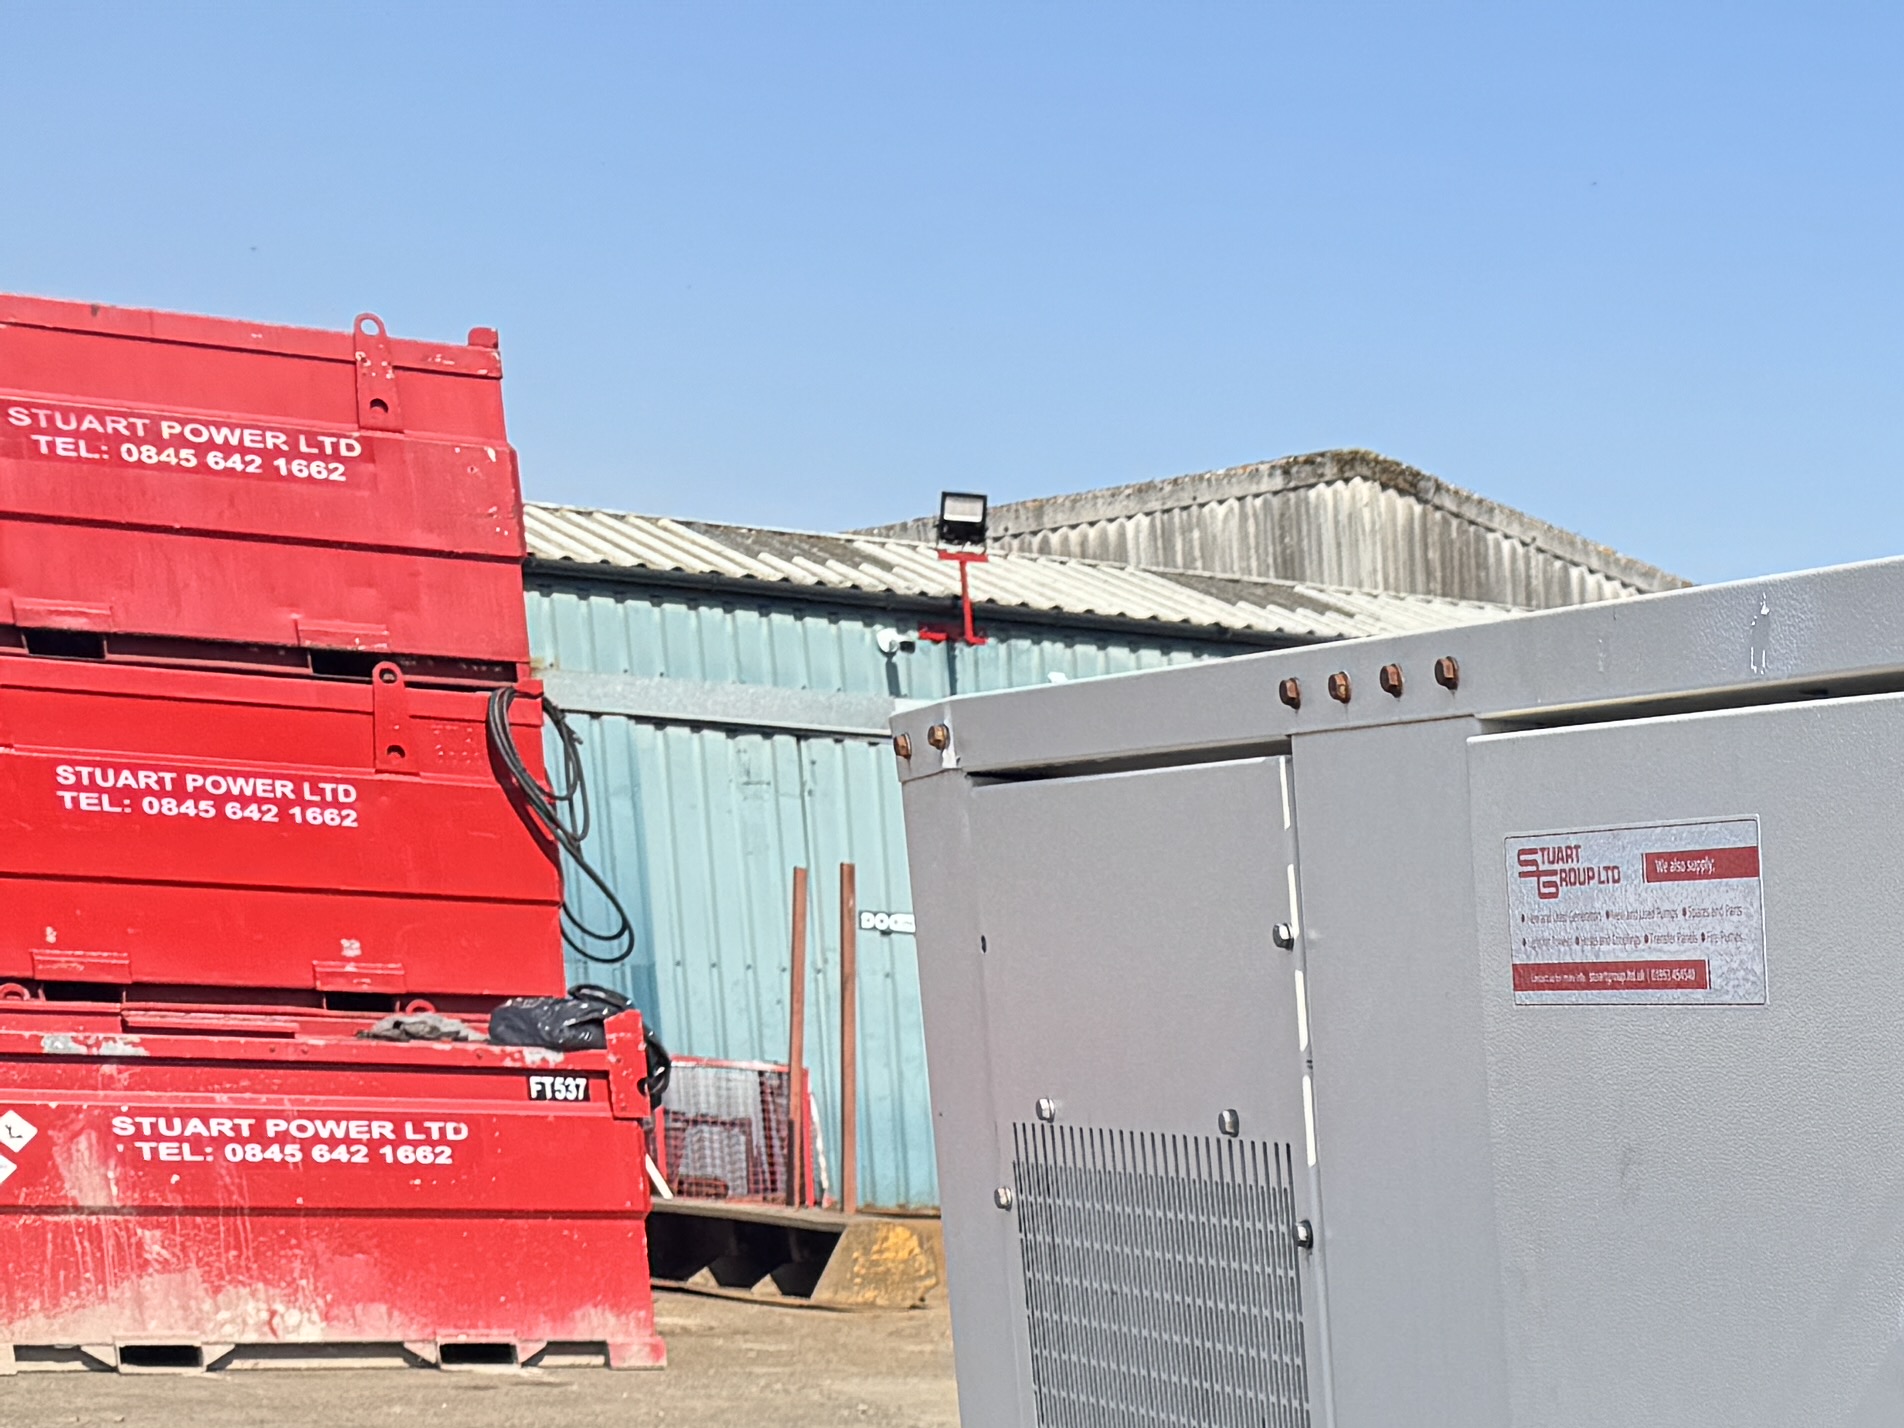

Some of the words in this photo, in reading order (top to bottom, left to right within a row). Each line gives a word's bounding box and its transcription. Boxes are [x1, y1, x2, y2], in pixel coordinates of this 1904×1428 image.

[7, 406, 150, 437] STUART
[160, 420, 289, 451] POWER
[299, 434, 362, 458] LTD
[31, 434, 110, 460] TEL:
[120, 442, 198, 468] 0845
[205, 451, 263, 474] 642
[273, 457, 347, 482] 1662
[55, 764, 177, 791] STUART
[185, 773, 296, 800] POWER
[303, 781, 357, 803] LTD
[56, 790, 132, 813] TEL:
[141, 796, 216, 819] 0845
[224, 801, 280, 823] 642
[288, 805, 359, 828] 1662
[1517, 844, 1581, 878] STUART
[1597, 865, 1621, 885] LTD
[1655, 858, 1668, 873] We
[1670, 857, 1685, 873] also
[529, 1076, 587, 1100] FT537
[111, 1116, 256, 1137] STUART
[266, 1118, 396, 1140] POWER
[405, 1121, 469, 1141] LTD
[134, 1141, 214, 1162] TEL:
[224, 1143, 303, 1163] 0845
[311, 1144, 370, 1163] 642
[379, 1144, 453, 1165] 1662
